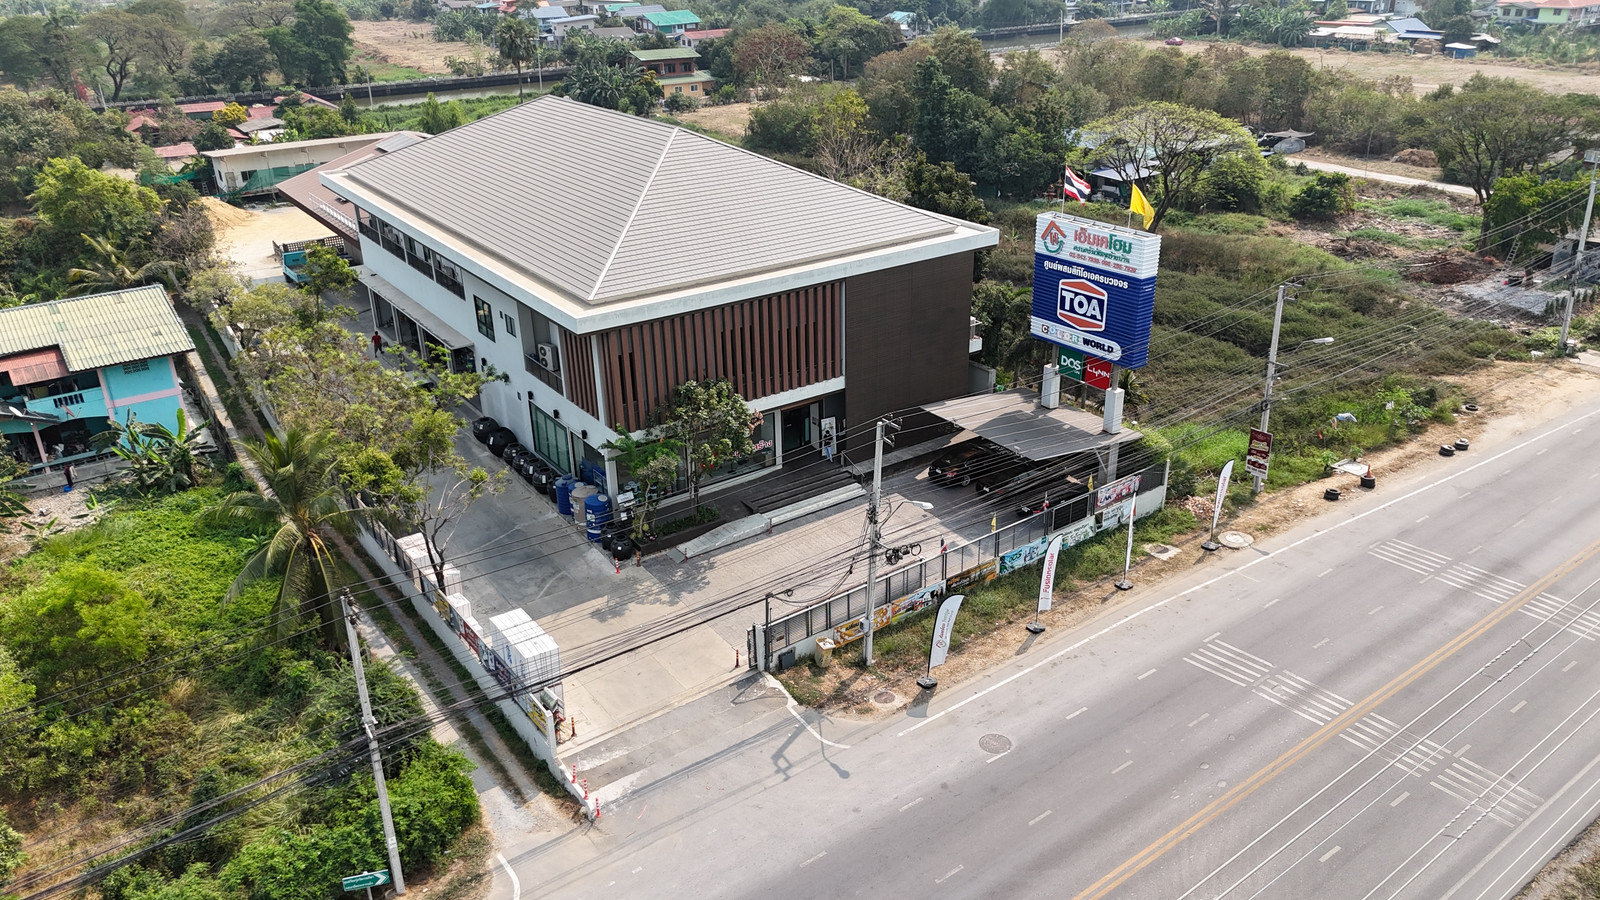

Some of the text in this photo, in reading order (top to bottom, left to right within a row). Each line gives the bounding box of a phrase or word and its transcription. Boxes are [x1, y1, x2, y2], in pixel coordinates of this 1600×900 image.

[1061, 290, 1102, 320] TOA
[1041, 325, 1114, 353] COLOR WORLD
[1061, 355, 1082, 371] DOS
